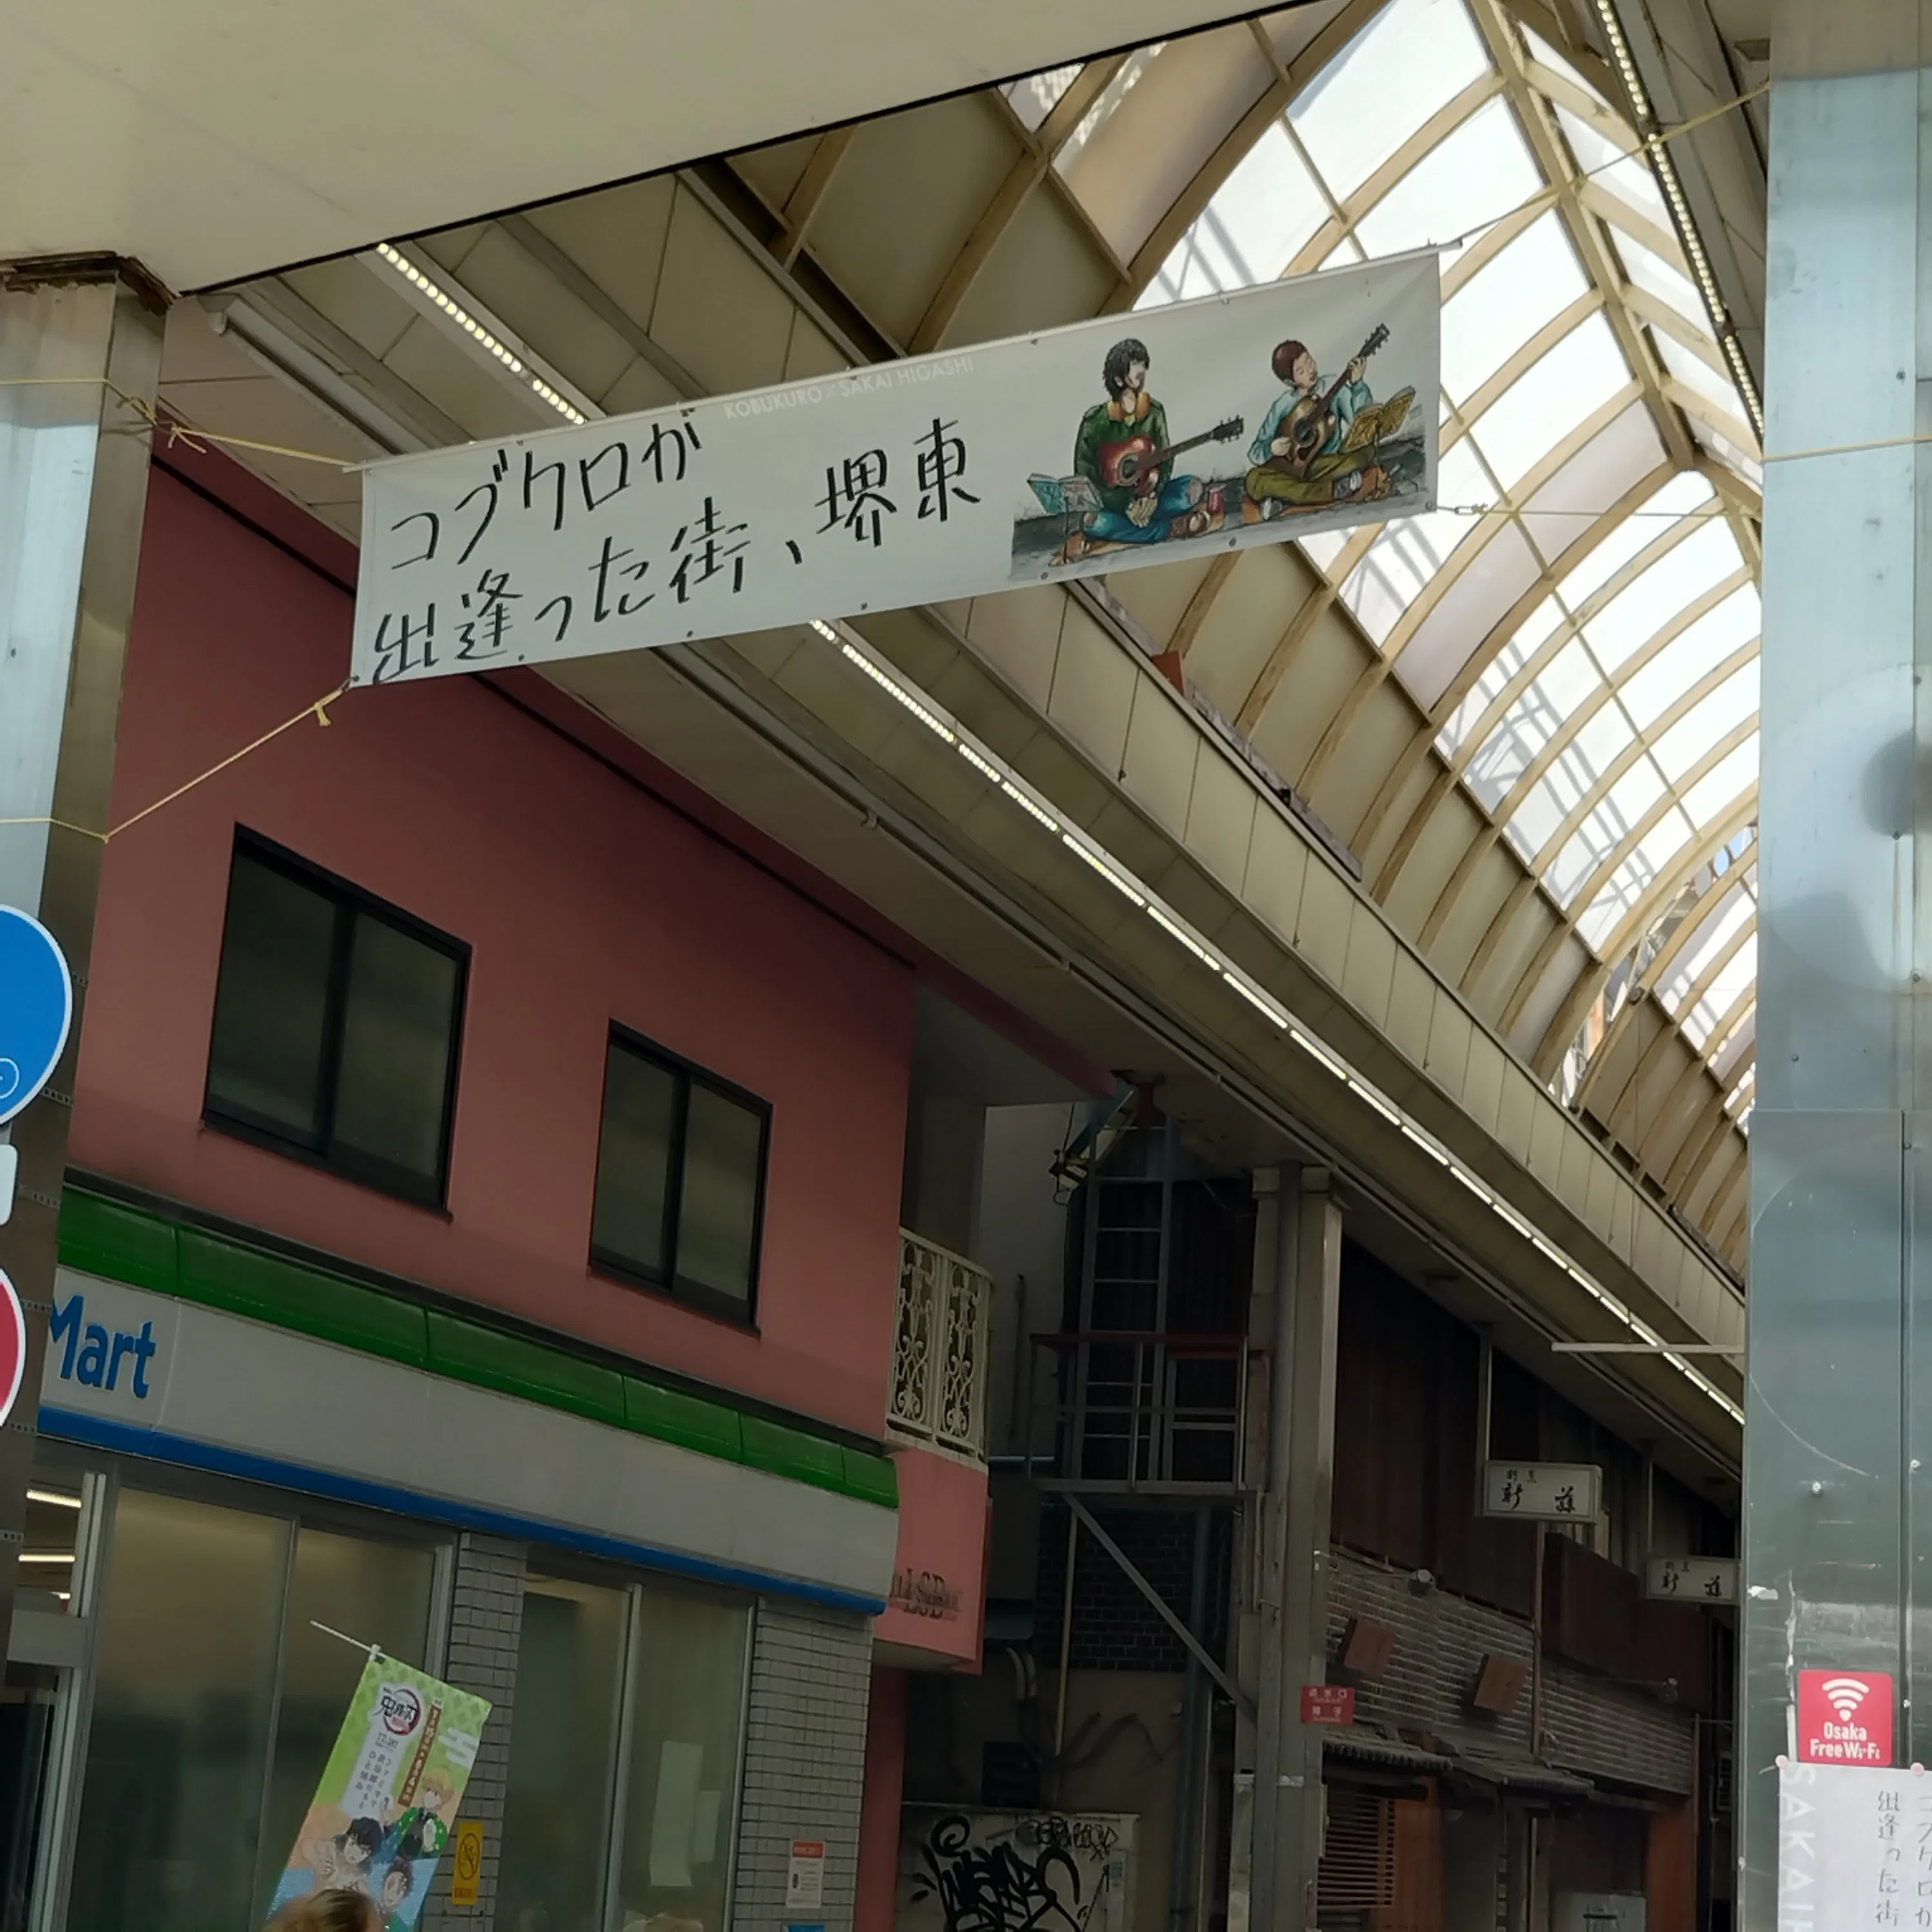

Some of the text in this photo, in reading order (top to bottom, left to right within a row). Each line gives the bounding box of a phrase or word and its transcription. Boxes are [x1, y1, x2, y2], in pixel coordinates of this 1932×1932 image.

[724, 386, 823, 420] KOBUKURO
[840, 372, 894, 399] SAKAI
[897, 355, 974, 390] HIGASHI
[390, 408, 703, 569] コブクロが
[50, 1294, 156, 1399] Mart
[1810, 1739, 1842, 1758] Free
[1823, 1721, 1868, 1741] Osaka
[1780, 1763, 1817, 1913] SAKAI
